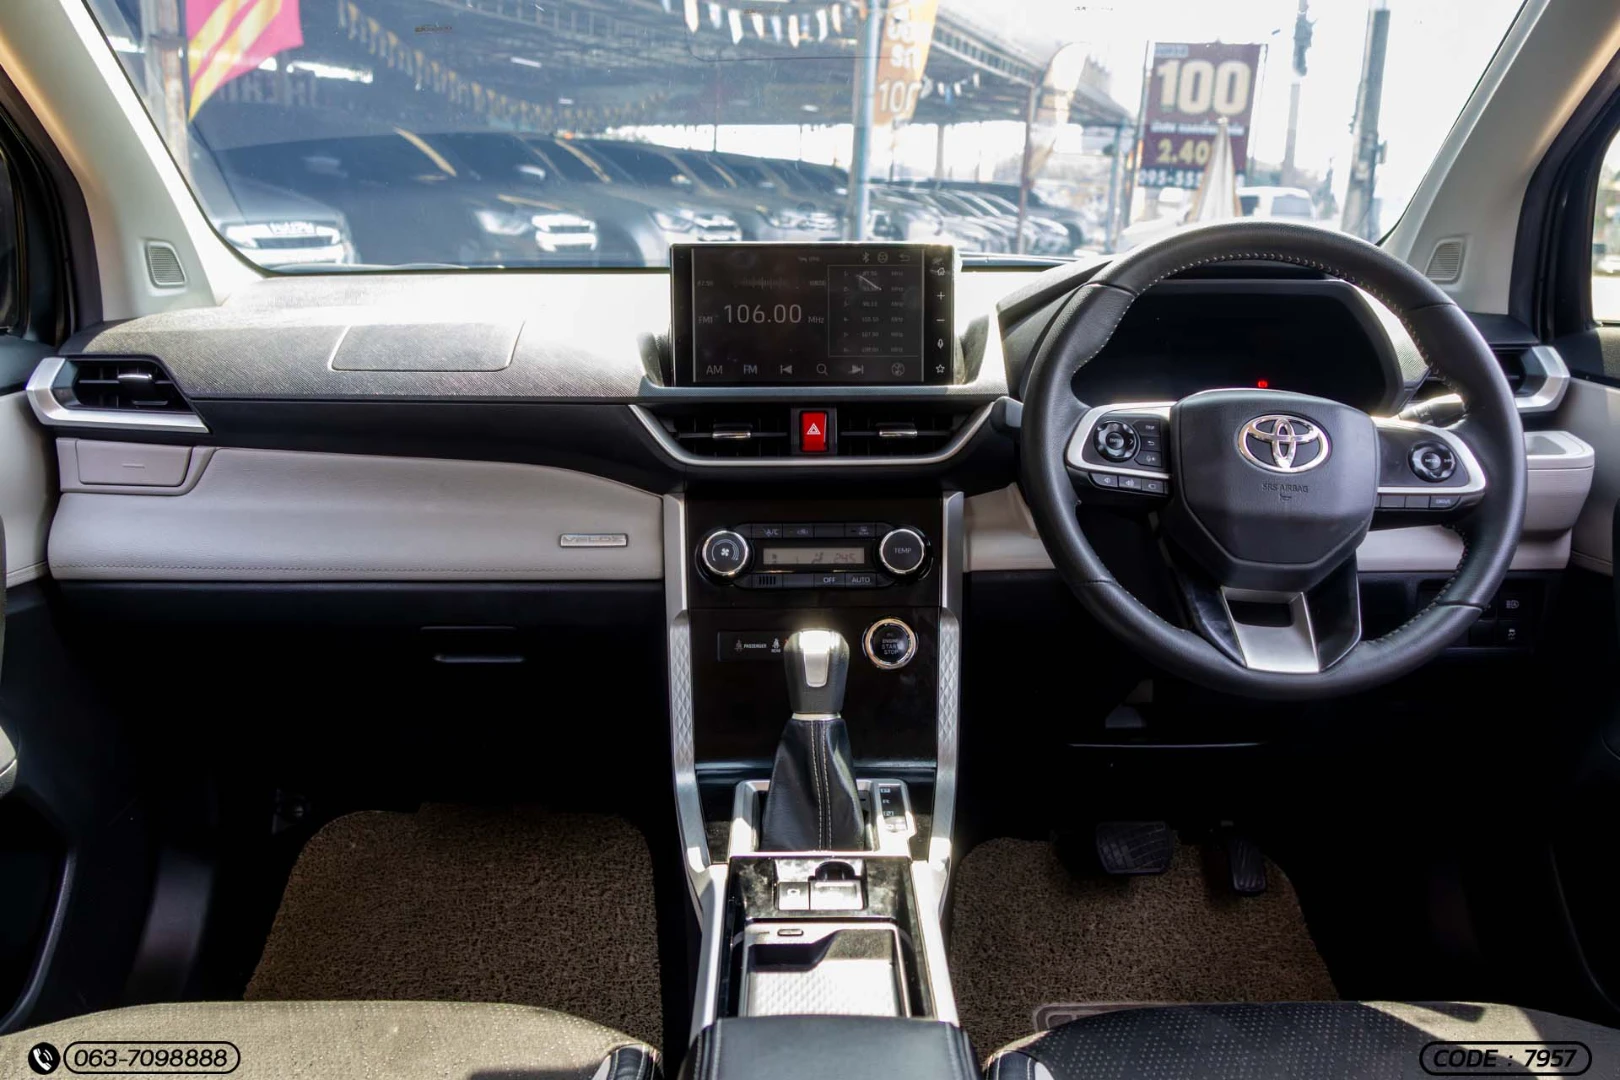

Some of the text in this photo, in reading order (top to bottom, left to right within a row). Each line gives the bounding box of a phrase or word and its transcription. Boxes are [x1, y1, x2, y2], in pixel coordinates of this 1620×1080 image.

[1156, 58, 1252, 115] 100
[723, 303, 802, 324] 106.00
[807, 315, 825, 325] MHz
[705, 364, 758, 376] AM FM
[1261, 482, 1309, 493] SRS AIRBAG
[893, 546, 912, 555] TEMP
[822, 576, 837, 584] OFF
[851, 576, 871, 584] AUTO
